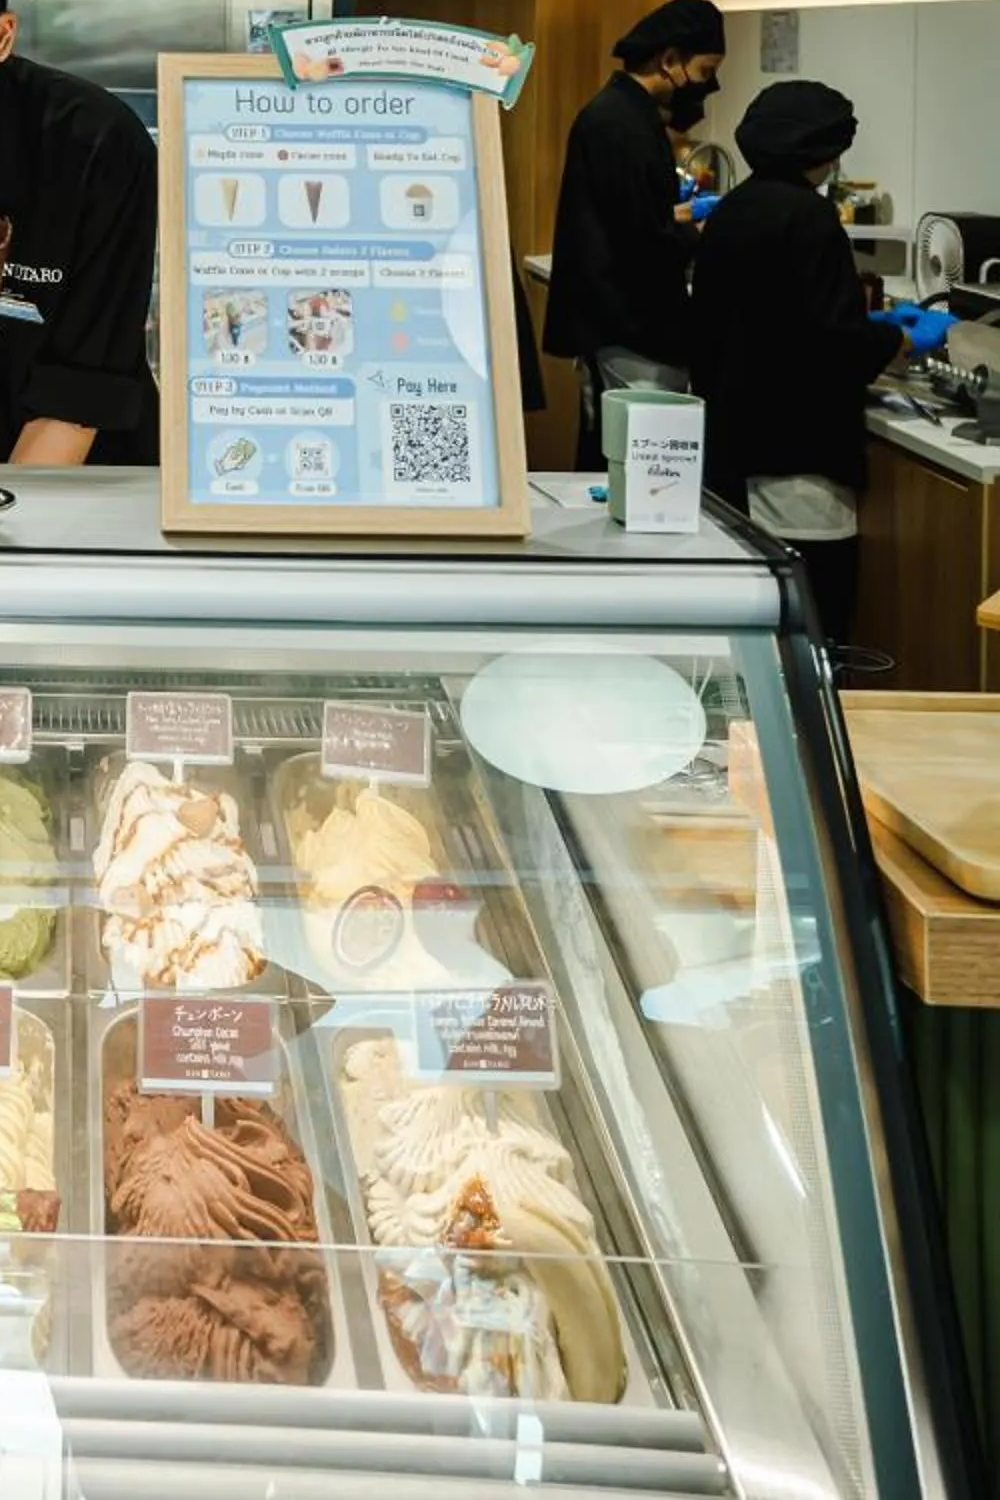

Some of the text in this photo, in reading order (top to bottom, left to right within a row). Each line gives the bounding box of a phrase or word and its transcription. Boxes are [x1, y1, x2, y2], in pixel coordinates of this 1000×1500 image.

[235, 90, 415, 116] How to order
[397, 378, 457, 397] Pay Here
